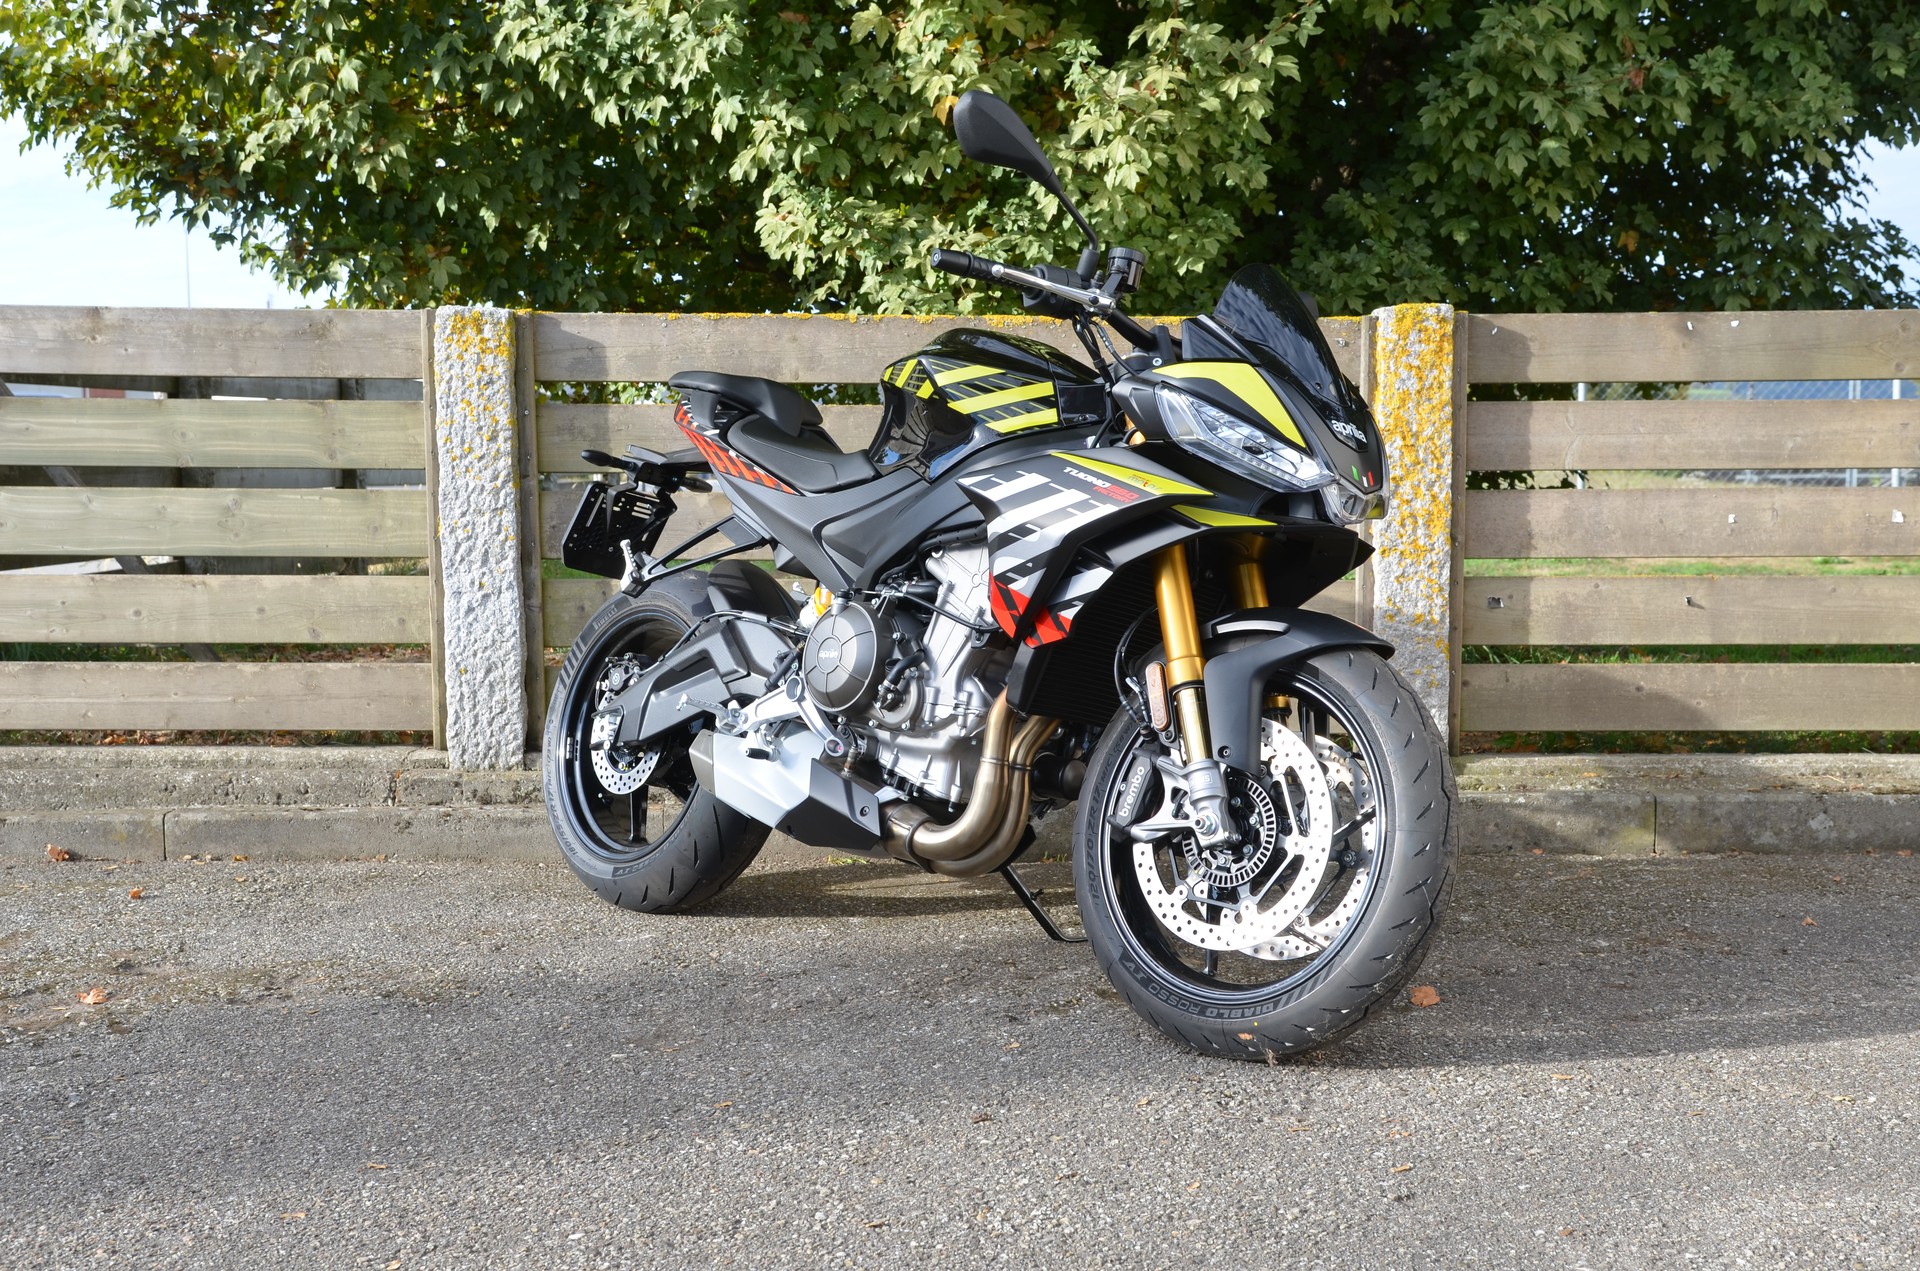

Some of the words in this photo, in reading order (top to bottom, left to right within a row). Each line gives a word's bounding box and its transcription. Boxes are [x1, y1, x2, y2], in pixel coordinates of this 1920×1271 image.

[1331, 419, 1368, 444] aprilia
[1063, 466, 1112, 488] TUONO
[592, 603, 618, 630] PIRELLI
[818, 648, 839, 660] aprilia
[1118, 766, 1146, 818] brembo
[1086, 838, 1100, 901] 120/70
[1121, 959, 1149, 981] IV
[1148, 983, 1201, 1015] ROSSO
[1205, 1002, 1275, 1019] DIABLO
